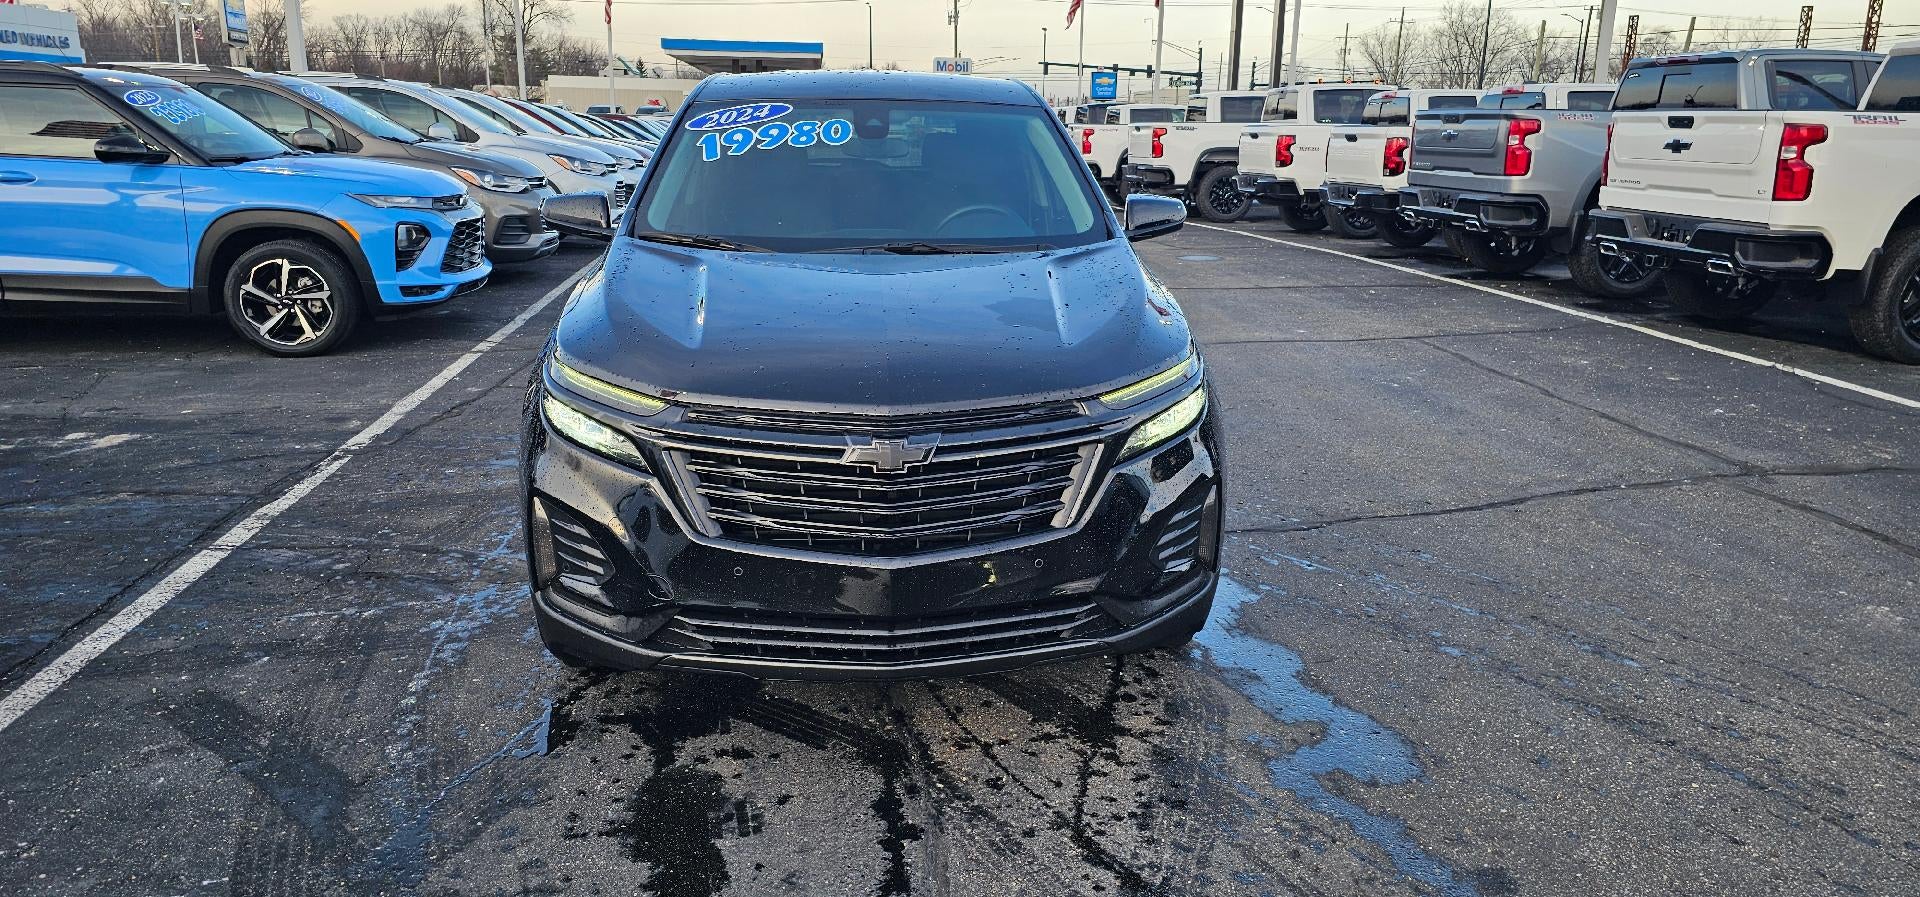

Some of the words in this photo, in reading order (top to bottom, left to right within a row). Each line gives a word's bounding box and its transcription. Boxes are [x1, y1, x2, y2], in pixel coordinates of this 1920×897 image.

[936, 60, 969, 72] Mobil
[705, 104, 770, 129] 2024
[696, 118, 853, 162] 19980
